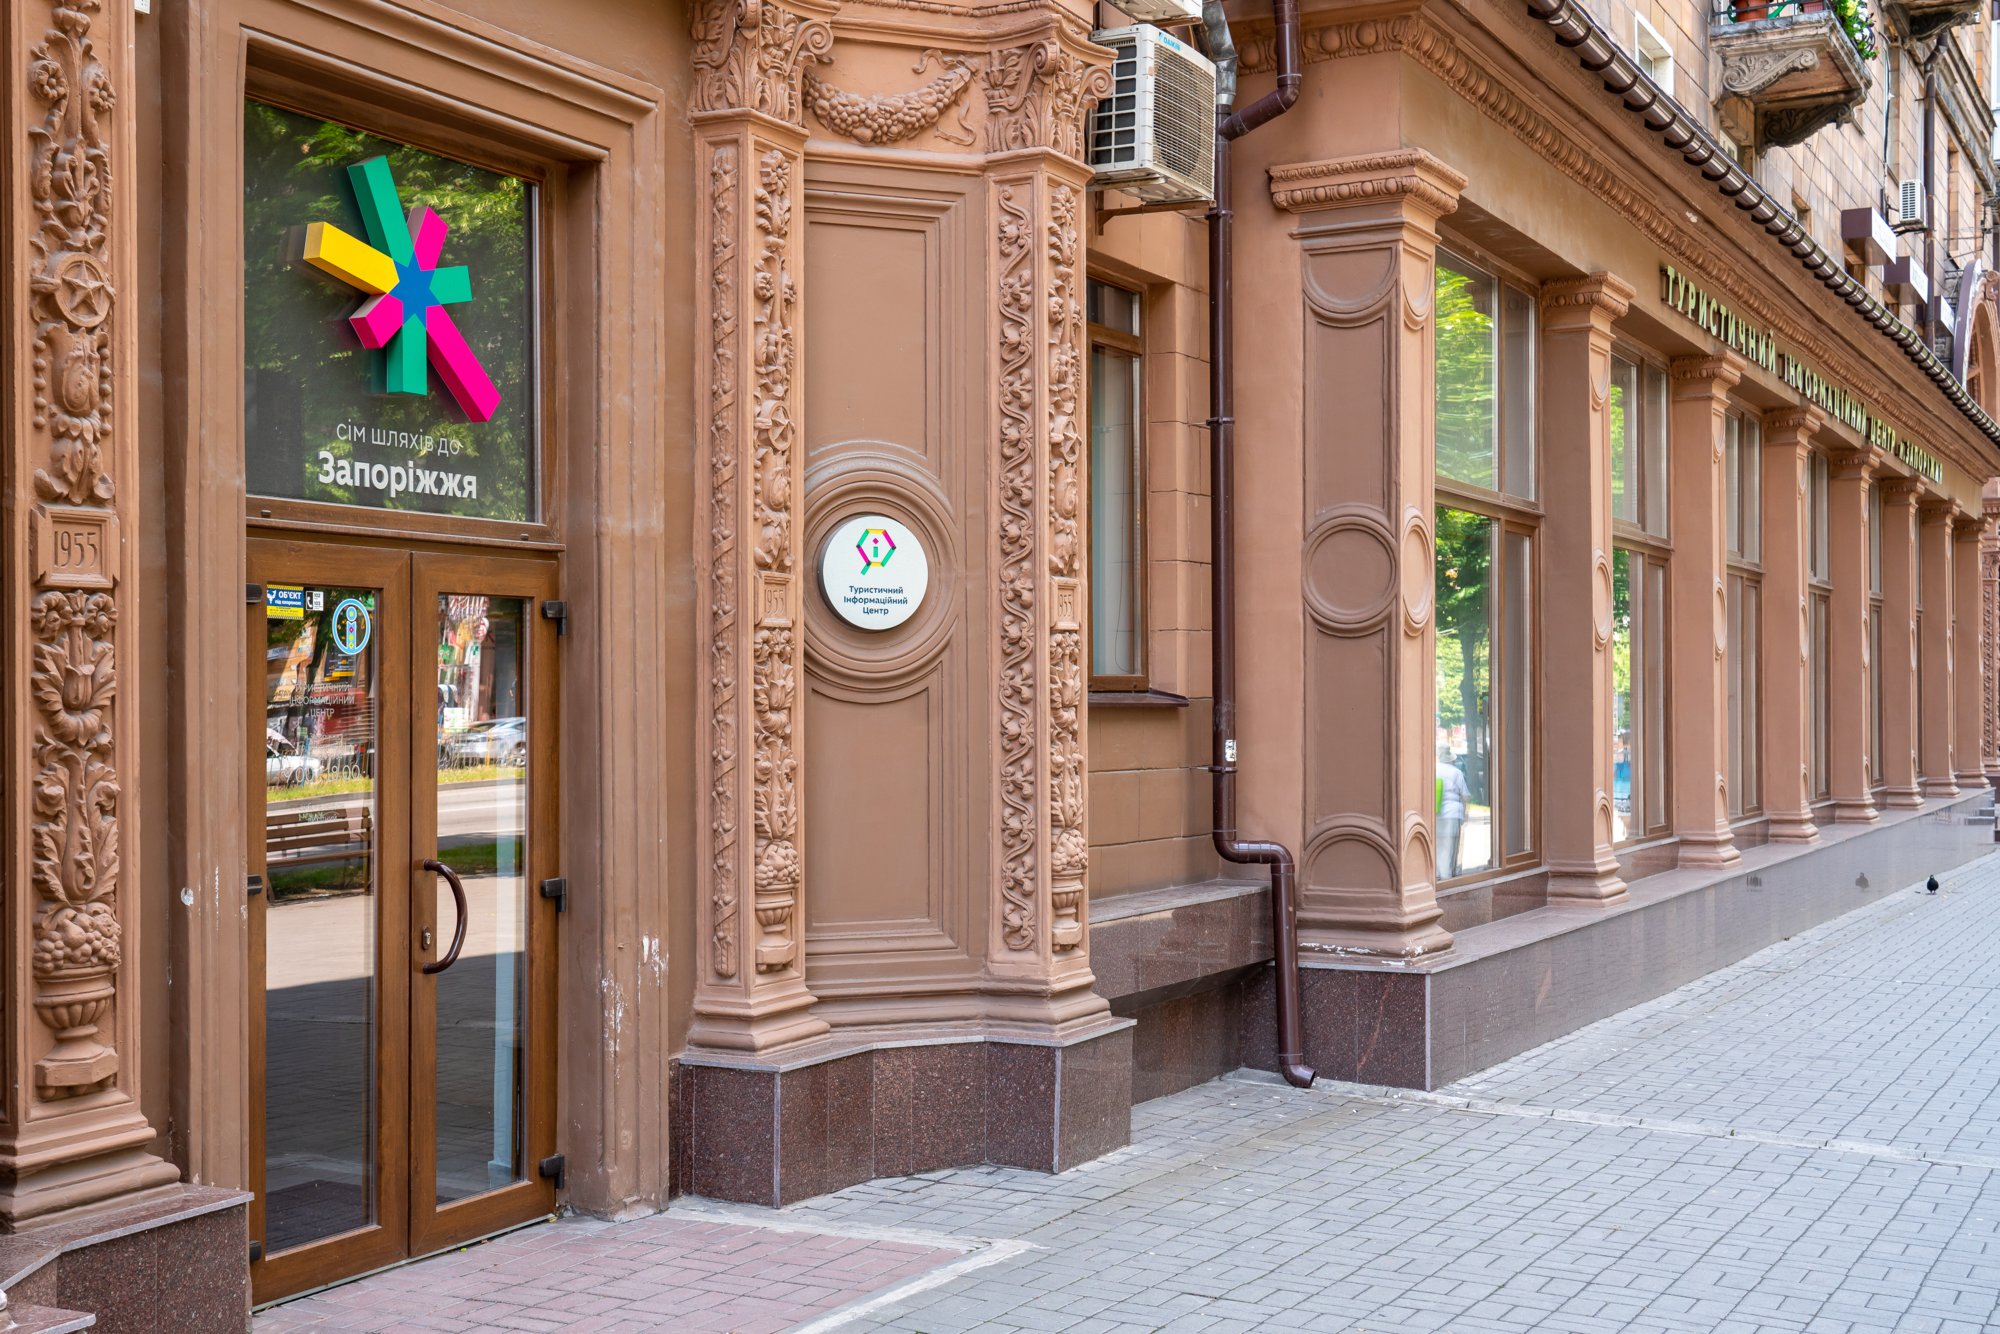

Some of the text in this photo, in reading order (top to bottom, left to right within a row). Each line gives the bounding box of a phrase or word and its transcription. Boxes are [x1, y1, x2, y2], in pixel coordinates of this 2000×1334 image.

[1667, 265, 1776, 374] ТУРИСТИЧНИЙ
[1784, 352, 1867, 436] ІНФОРМАЦІЙНИЙ
[1870, 415, 1896, 453] ЦЕНТР
[336, 418, 461, 457] сім шляхів до
[318, 450, 477, 499] Запоріжжя
[54, 530, 98, 568] 1955
[843, 595, 908, 605] Інформаційний
[848, 585, 904, 594] Туристичний
[862, 606, 889, 615] Центр
